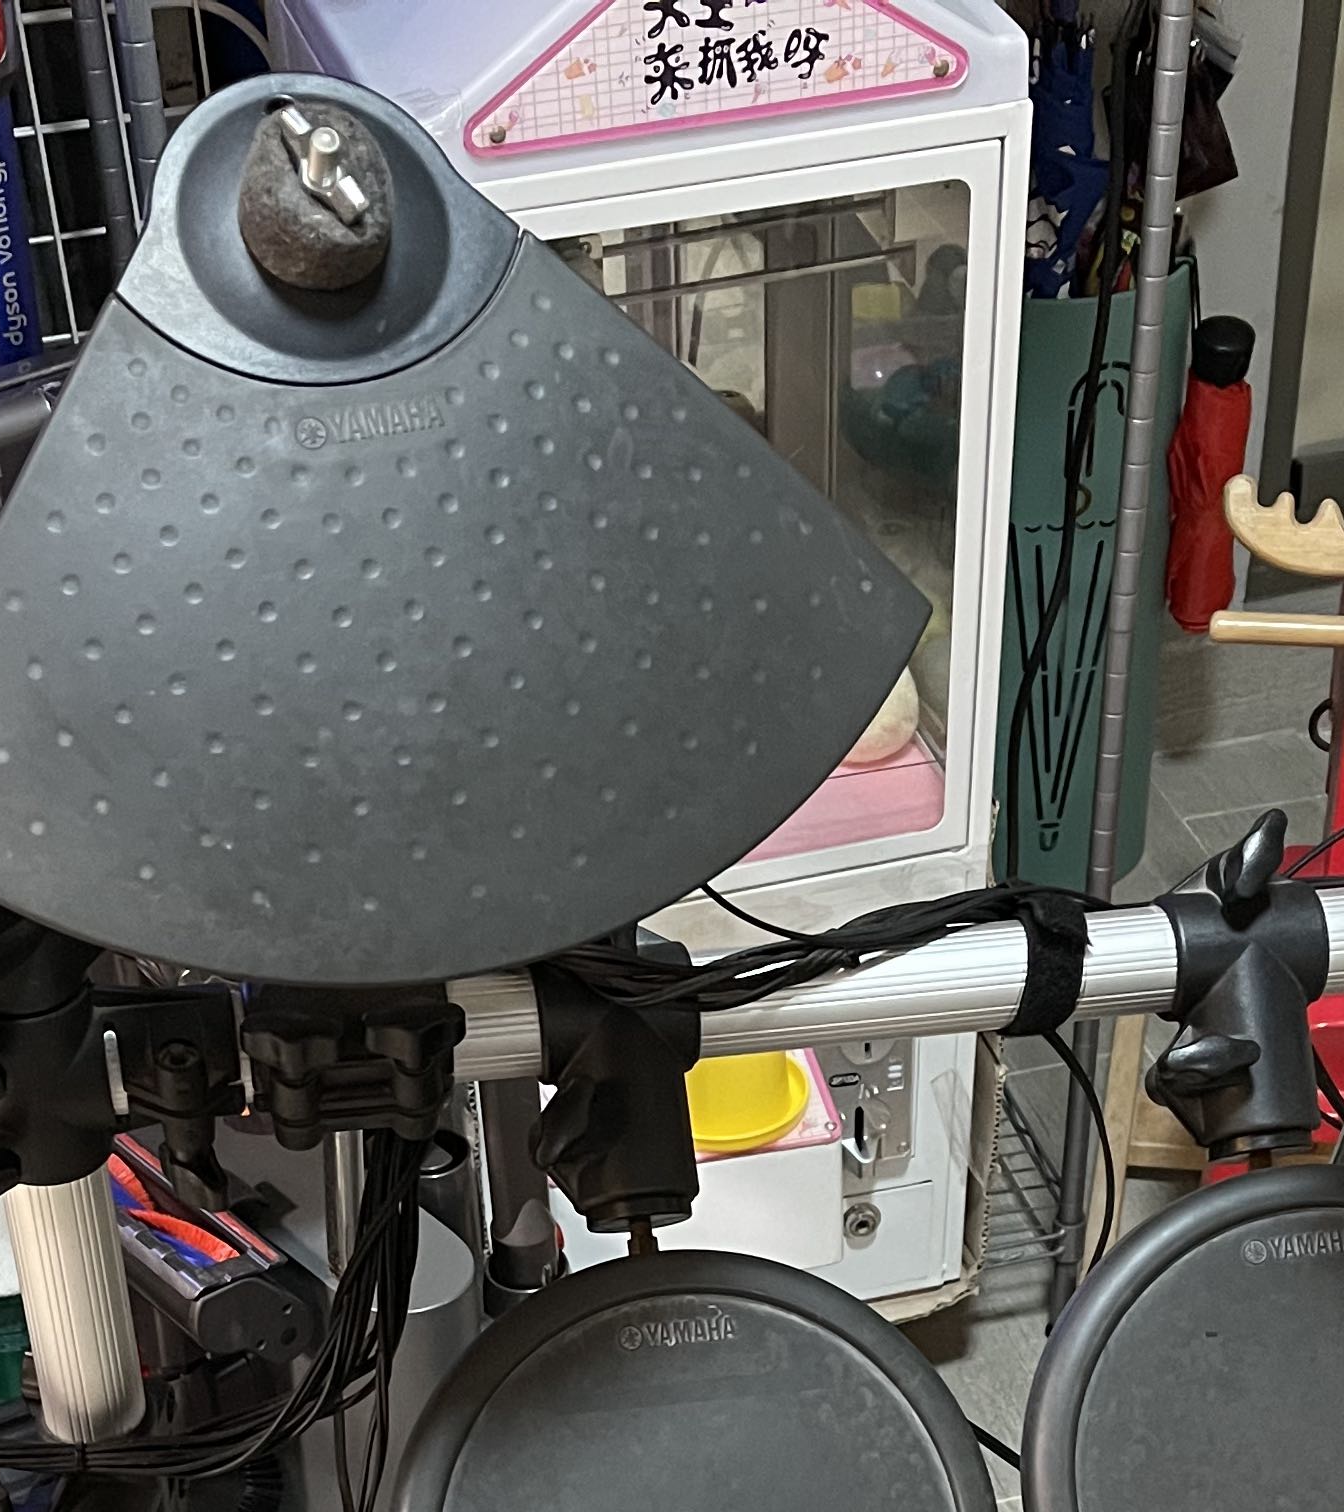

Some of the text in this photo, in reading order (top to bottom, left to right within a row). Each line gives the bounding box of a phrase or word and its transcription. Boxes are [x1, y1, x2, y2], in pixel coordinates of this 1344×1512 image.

[3, 271, 28, 346] dyson
[326, 397, 446, 443] YAMAHA
[642, 1314, 736, 1346] YAMAHA
